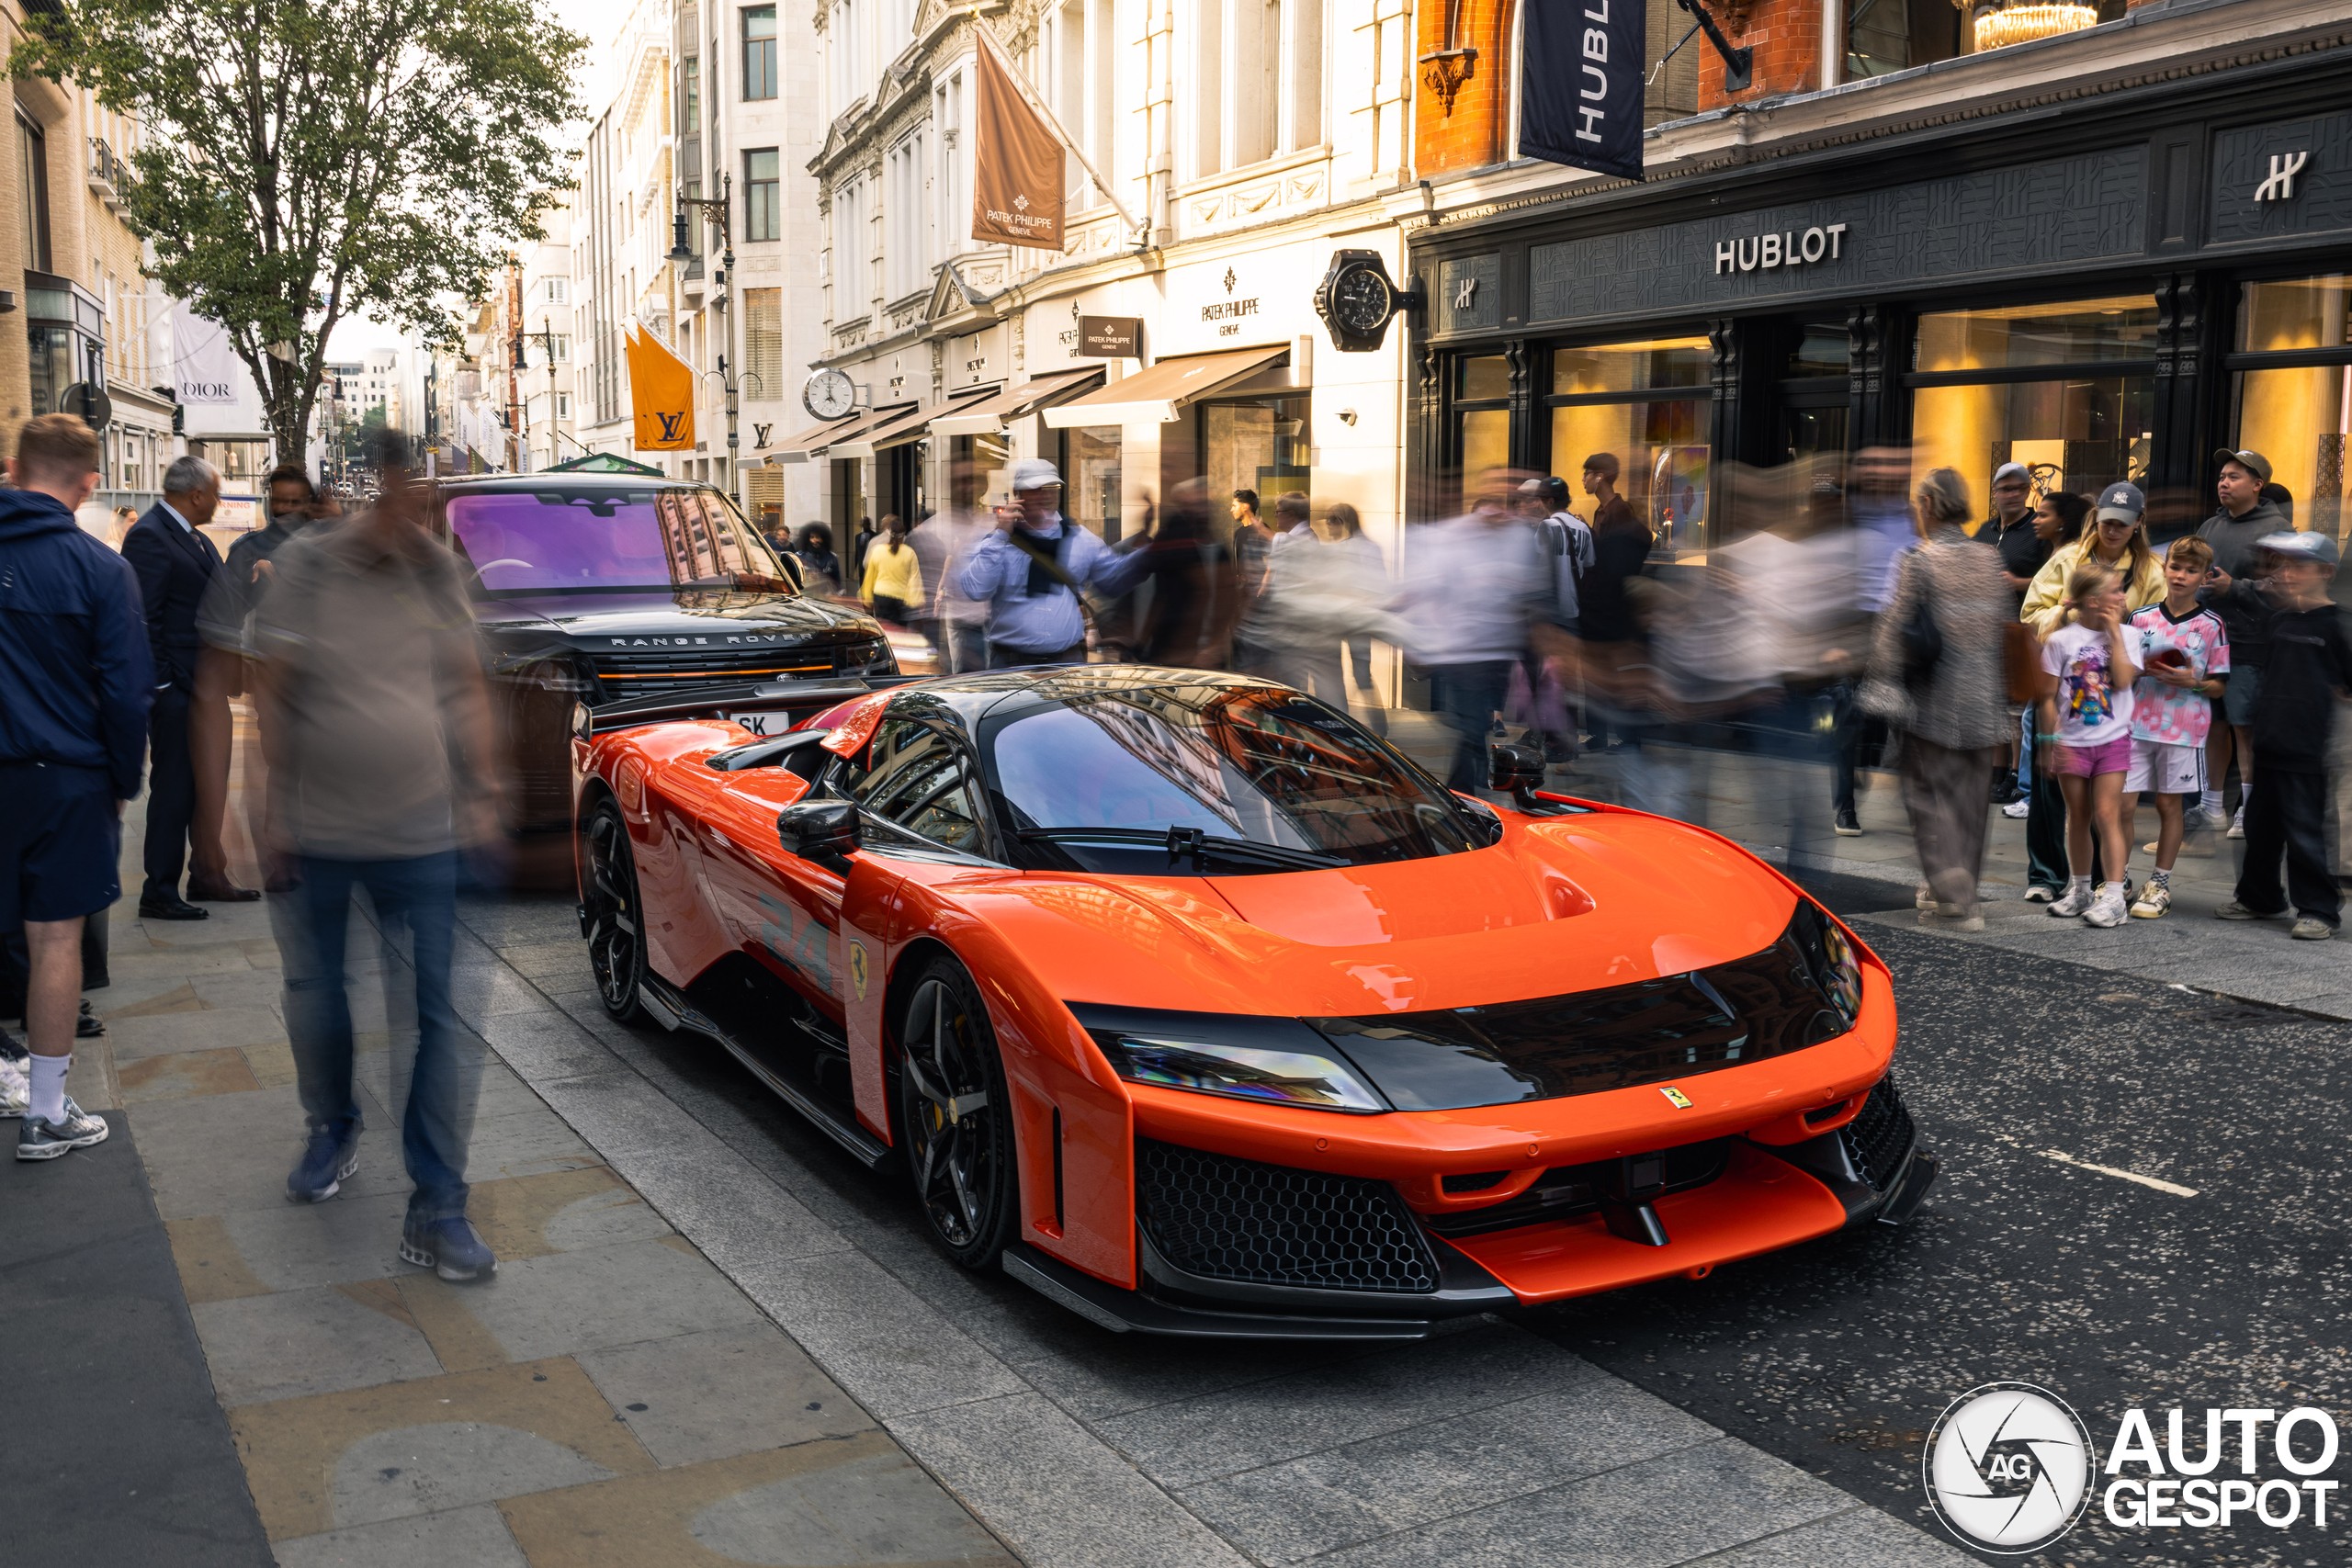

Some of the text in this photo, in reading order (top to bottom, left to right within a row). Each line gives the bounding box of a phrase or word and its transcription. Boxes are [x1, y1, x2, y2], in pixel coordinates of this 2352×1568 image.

[1576, 0, 1609, 143] HUBL
[987, 209, 1052, 229] PATEK PHILIPPE
[1008, 226, 1031, 236] GENEVE
[1715, 223, 1846, 275] HUBLOT
[1202, 298, 1259, 321] PATEK PHILIPPE
[1105, 336, 1131, 344] PHILIPPE
[184, 382, 230, 397] DIOR
[611, 633, 813, 647] RANGE ROVER
[739, 716, 766, 736] SK
[991, 1084, 1003, 1166] MICHELIN
